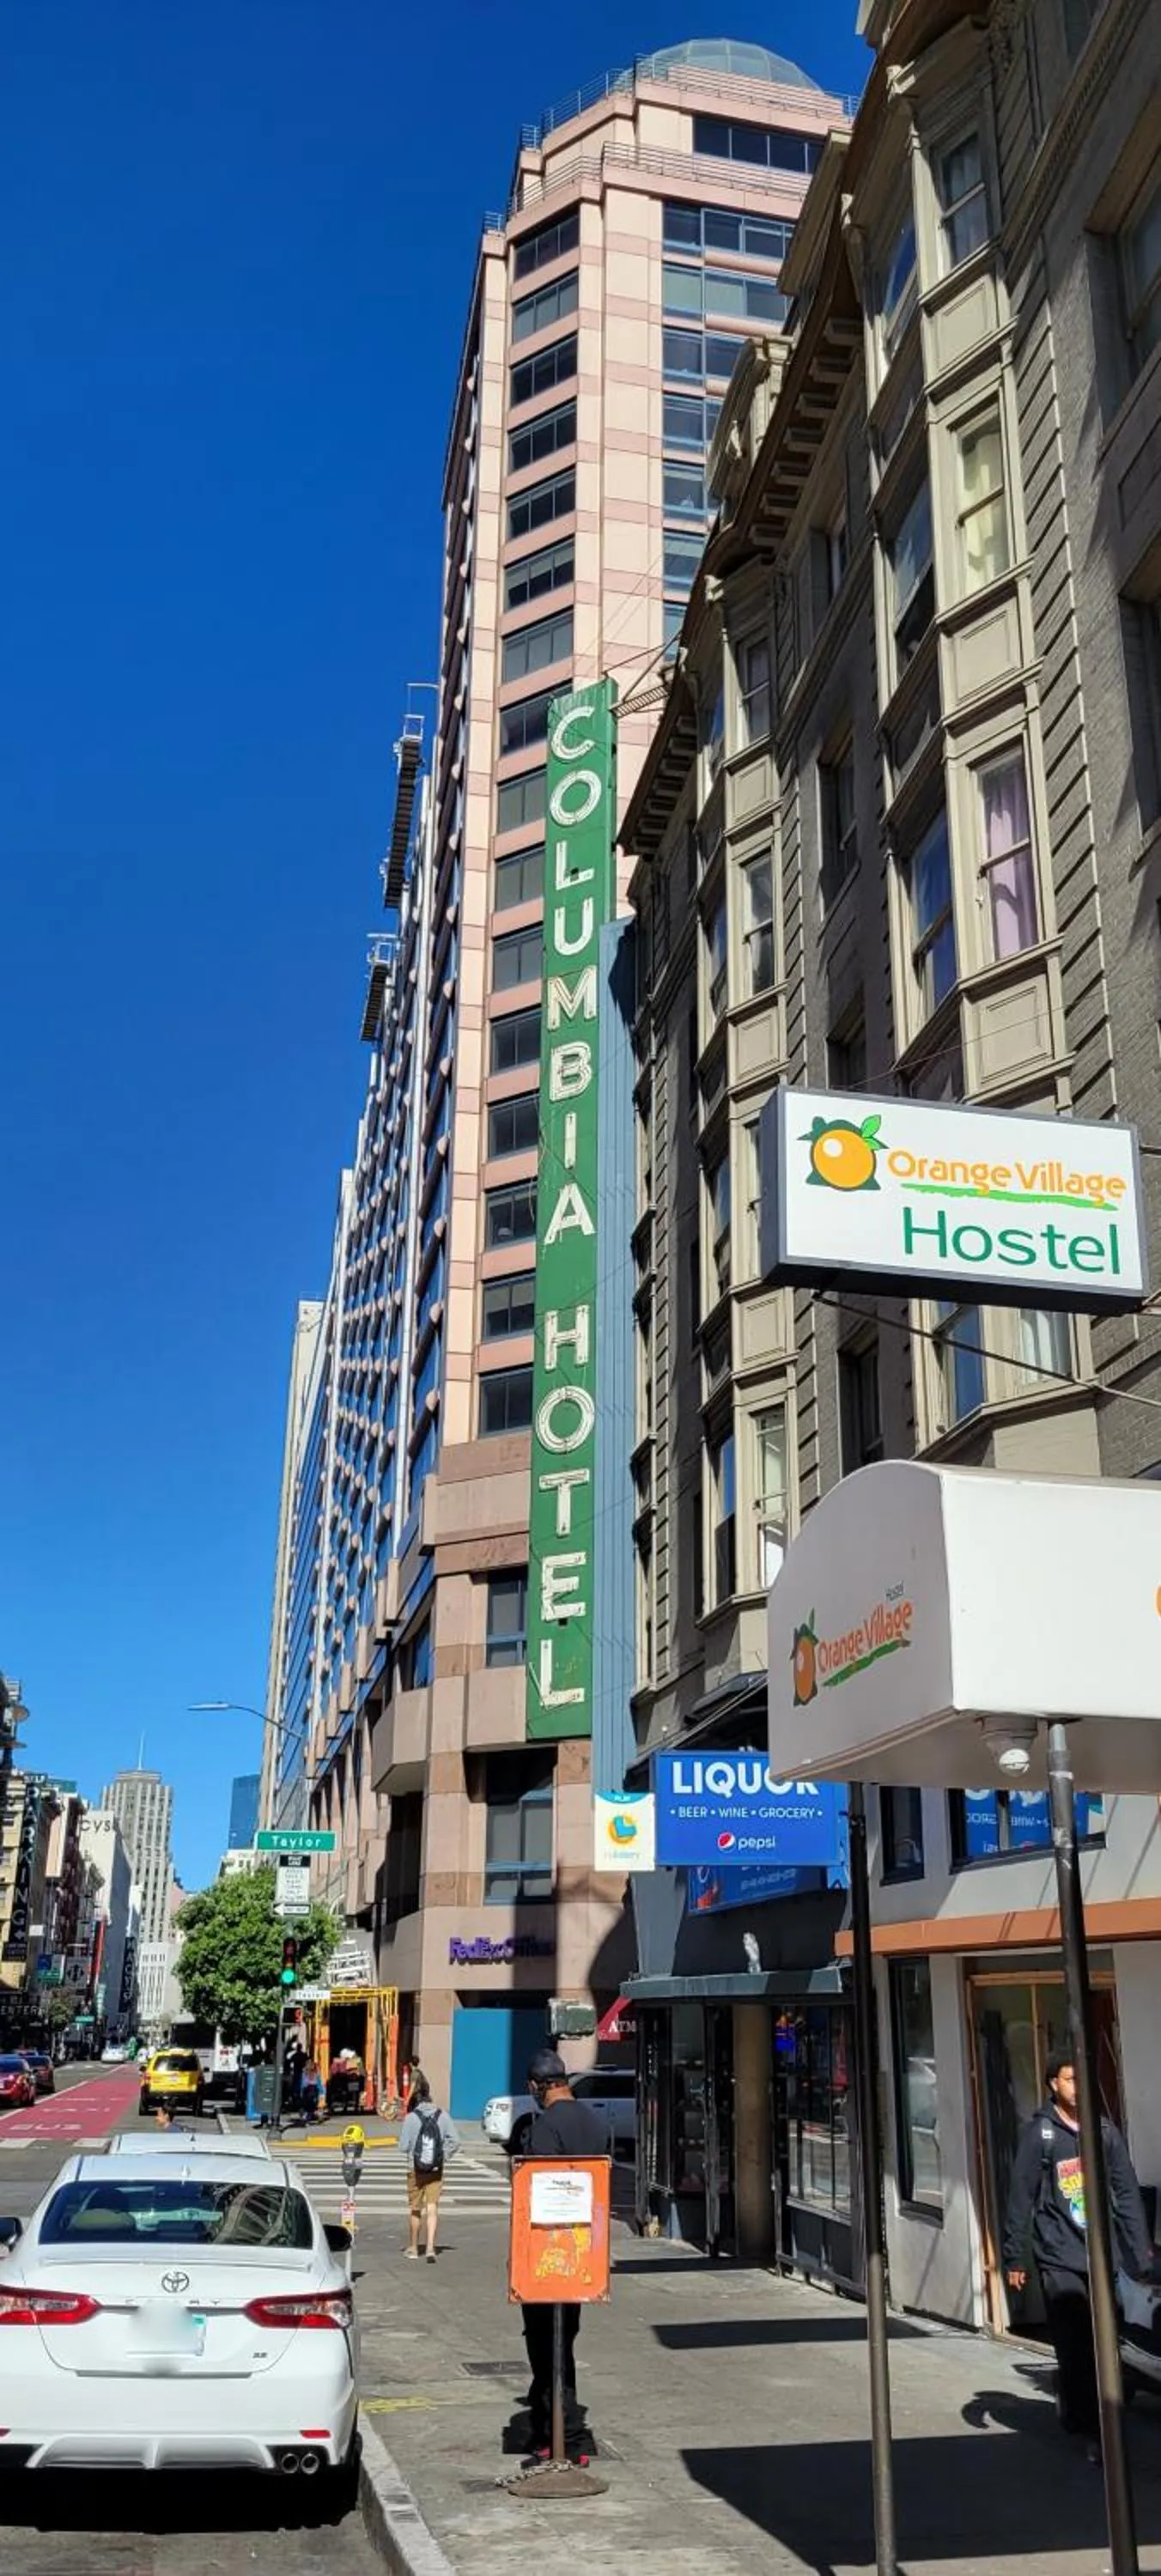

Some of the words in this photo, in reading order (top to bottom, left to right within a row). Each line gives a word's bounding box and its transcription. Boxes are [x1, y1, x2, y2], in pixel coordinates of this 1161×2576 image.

[544, 705, 602, 1244] COLUMBIA
[887, 1149, 1012, 1194] Orange
[1014, 1159, 1127, 1206] Village
[903, 1206, 1121, 1275] Hostel
[536, 1304, 595, 1707] HOTEL
[818, 1629, 864, 1674] Orange
[864, 1601, 912, 1649] Village
[271, 1834, 322, 1849] Taylor
[678, 1806, 708, 1818] BEER
[719, 1807, 750, 1819] WINE
[758, 1807, 815, 1819] GROCERY
[738, 1836, 776, 1850] pepsi
[12, 1786, 40, 1926] PARKING
[609, 2020, 636, 2032] ATM
